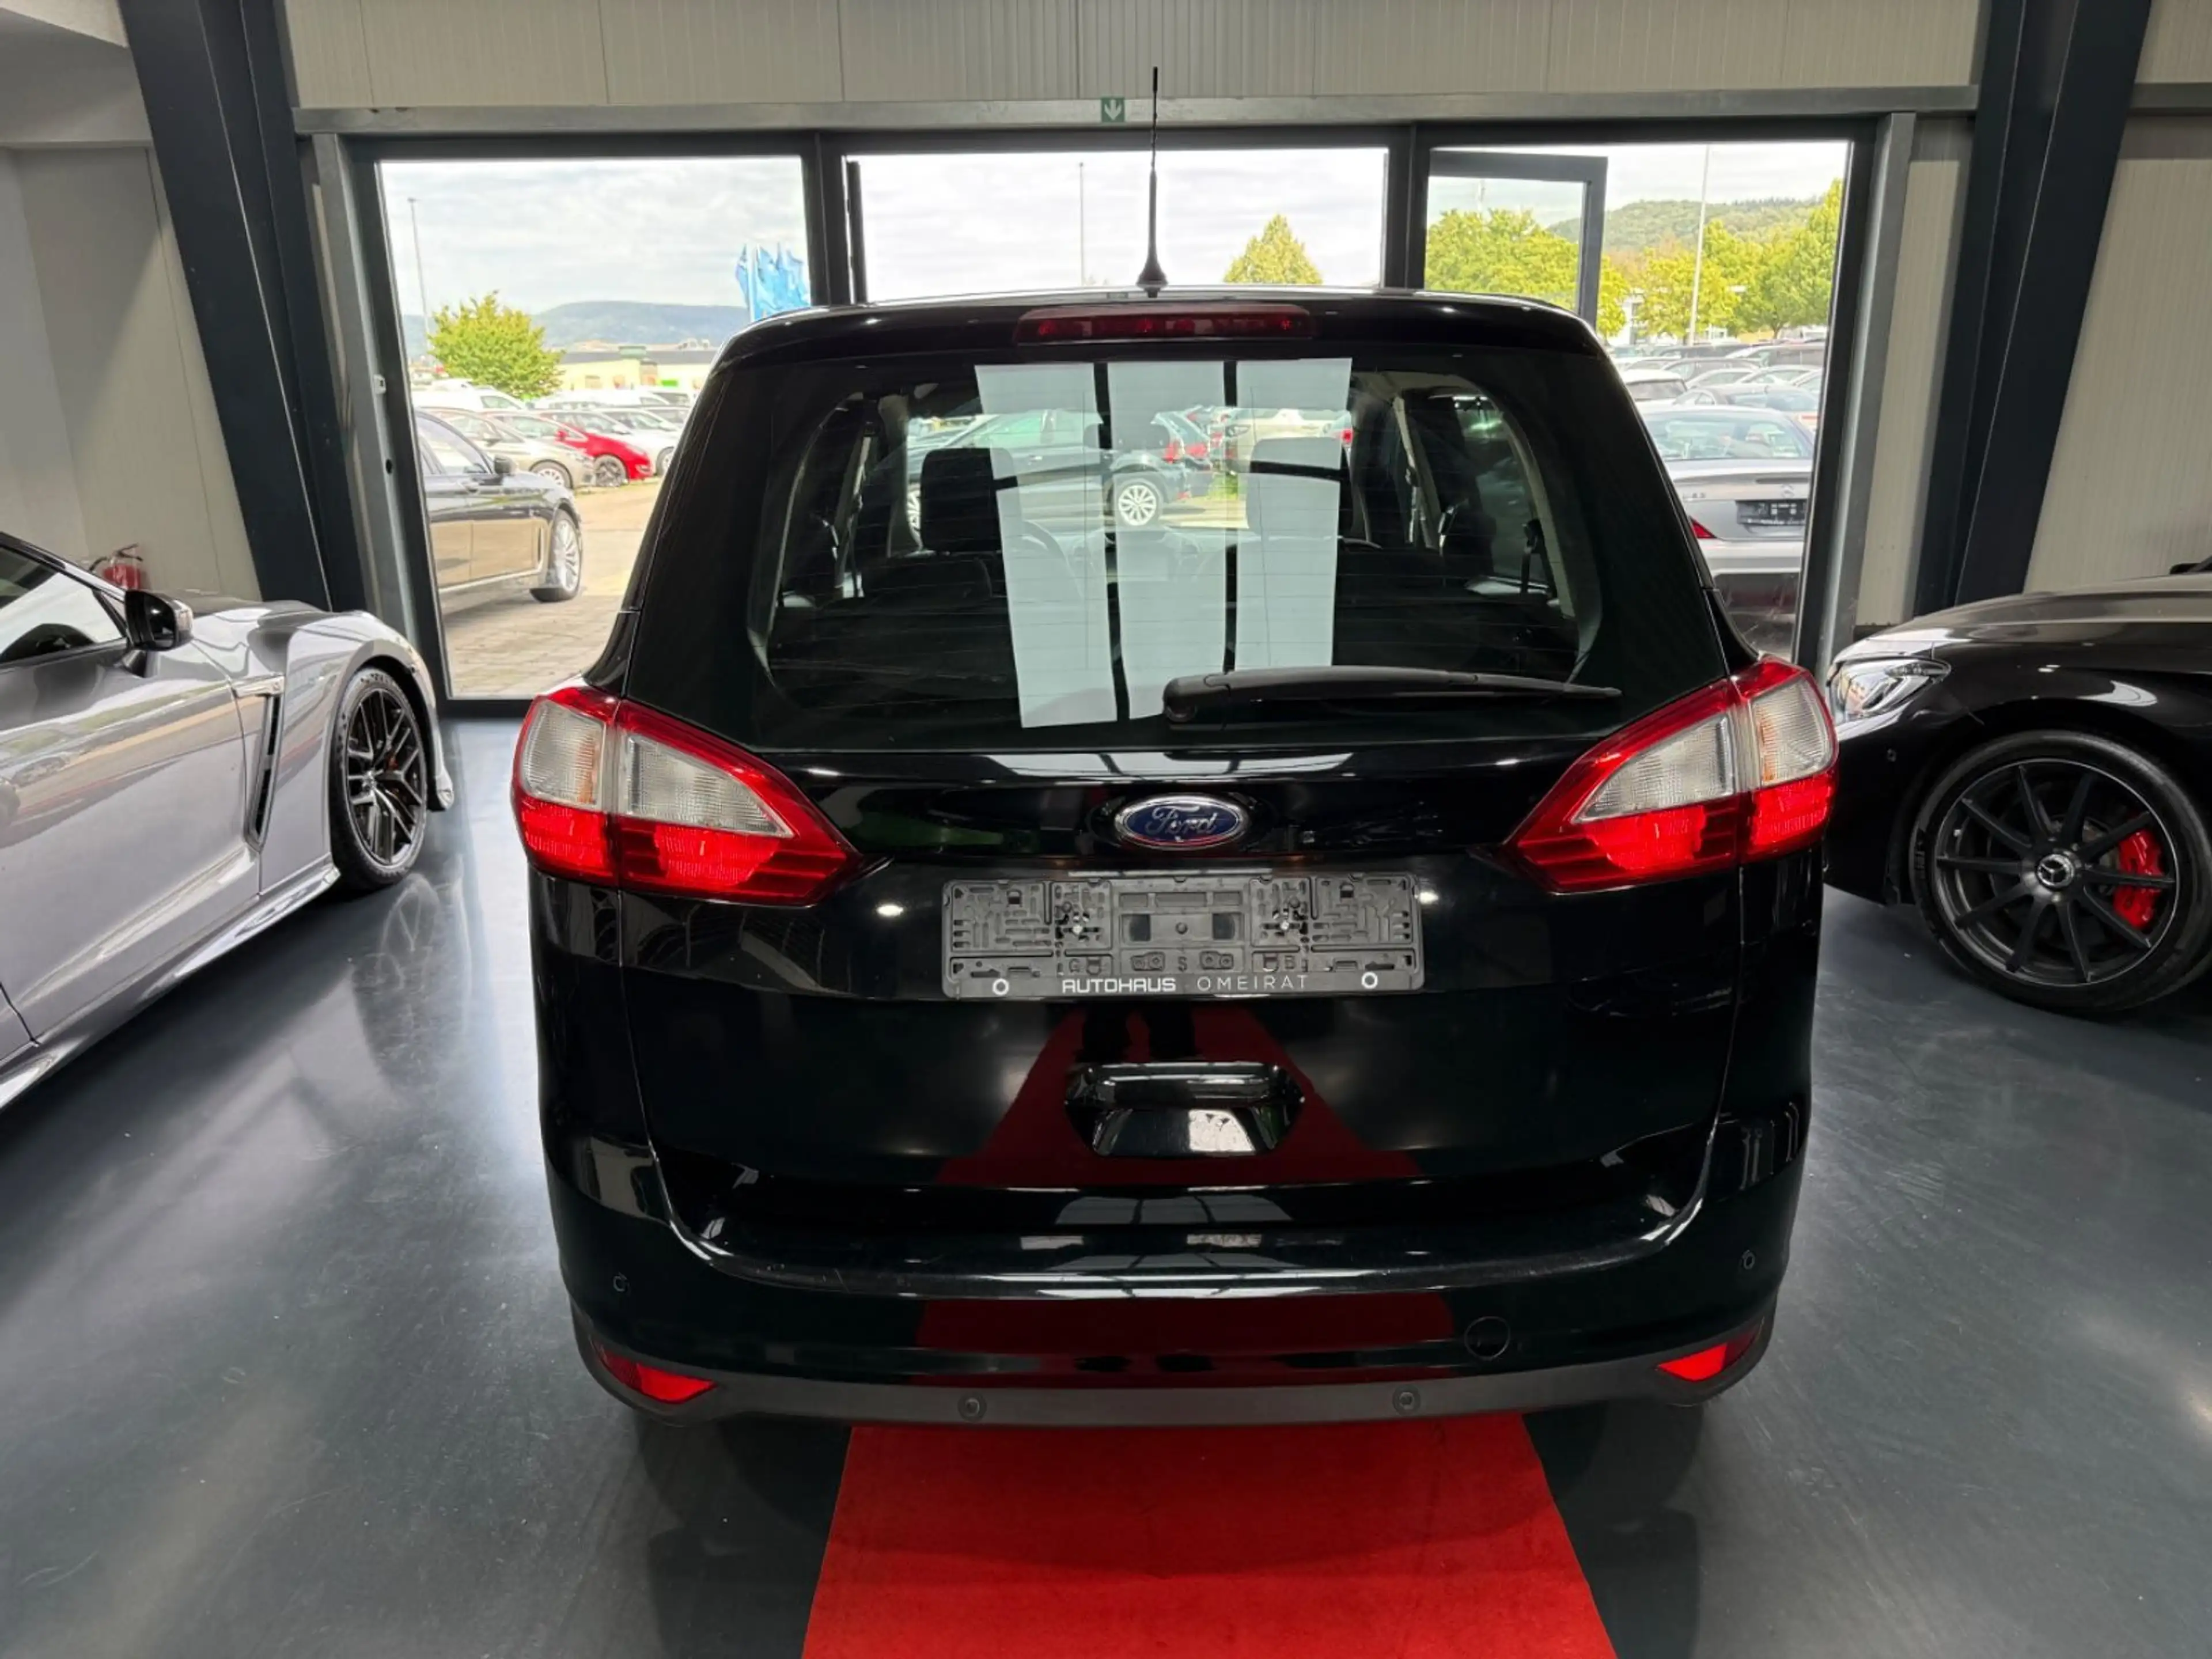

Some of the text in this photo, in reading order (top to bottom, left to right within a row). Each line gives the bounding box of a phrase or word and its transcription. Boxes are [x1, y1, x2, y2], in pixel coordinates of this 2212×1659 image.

[1145, 805, 1218, 835] Ford
[1062, 975, 1309, 994] AUTOHAUS OMEIRAT
